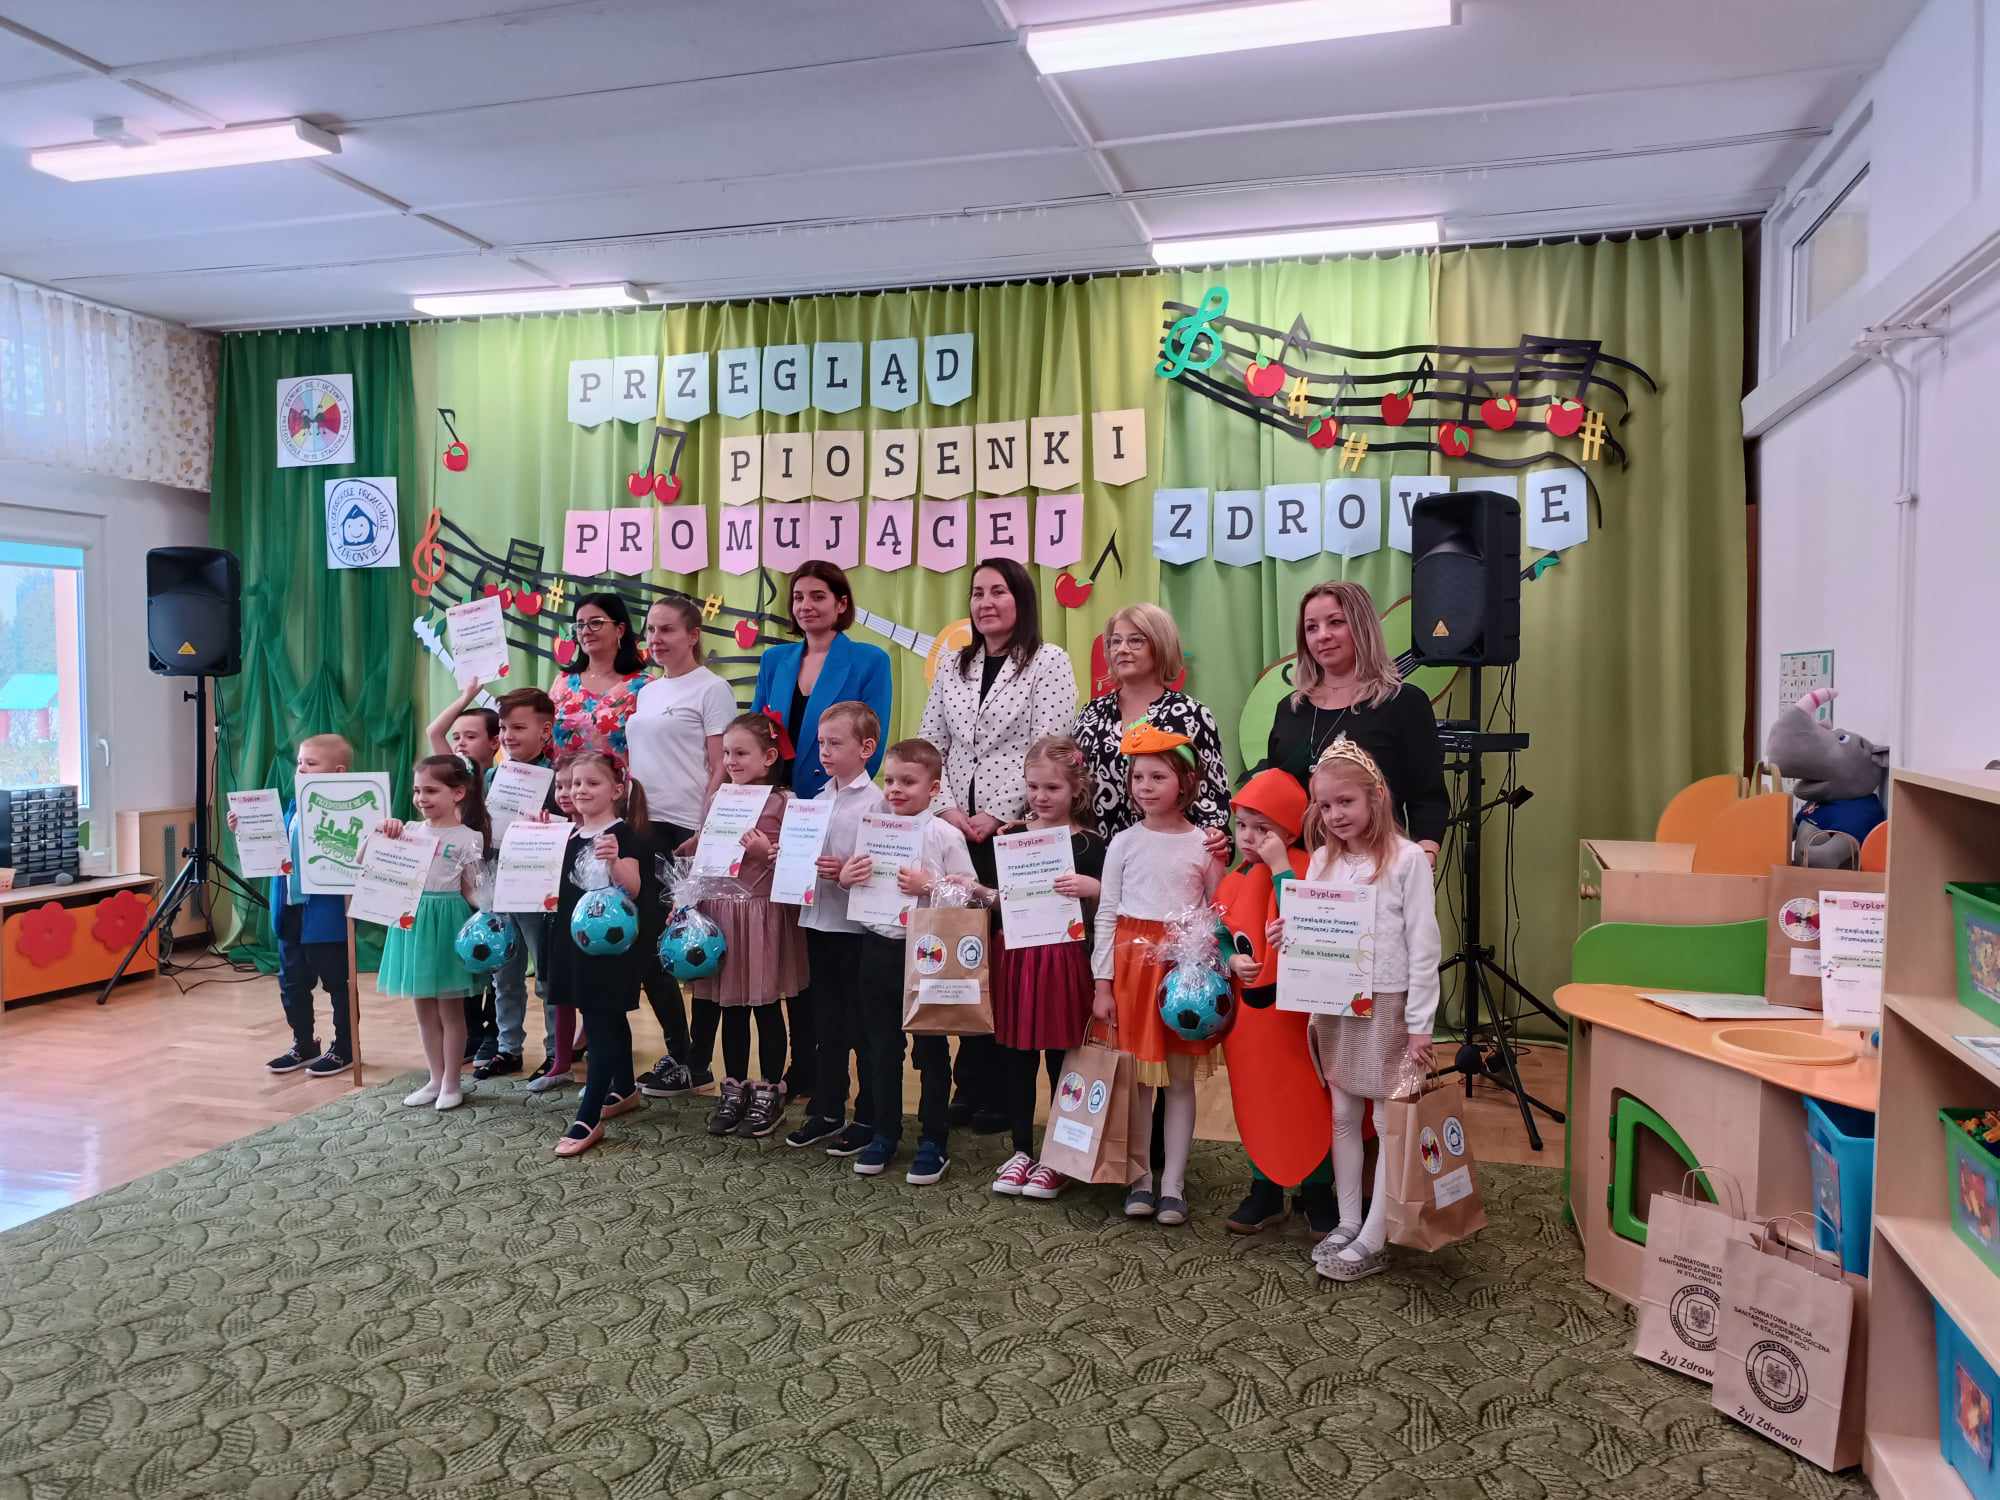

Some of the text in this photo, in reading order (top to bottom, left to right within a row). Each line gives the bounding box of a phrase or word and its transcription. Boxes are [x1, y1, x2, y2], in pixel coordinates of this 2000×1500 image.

[580, 347, 960, 402] PRZEGLĄD
[731, 425, 1125, 482] PIOSENKI
[576, 484, 1570, 555] PROMUJĄCEJ ZDROE
[1310, 889, 1341, 899] Dyplom
[1658, 1256, 1722, 1280] SANITARNO-EPIDEMIO
[1673, 1254, 1711, 1270] POWIATOWA
[1684, 1271, 1716, 1285] STALOWEJ
[1748, 1305, 1813, 1337] POWIATOWA STACJA
[1759, 1324, 1793, 1343] STALOWEJ
[1794, 1340, 1810, 1351] WOLI
[1660, 1349, 1714, 1377] Żyj Zdrow
[1737, 1404, 1802, 1449] Żyj Zdrowo!
